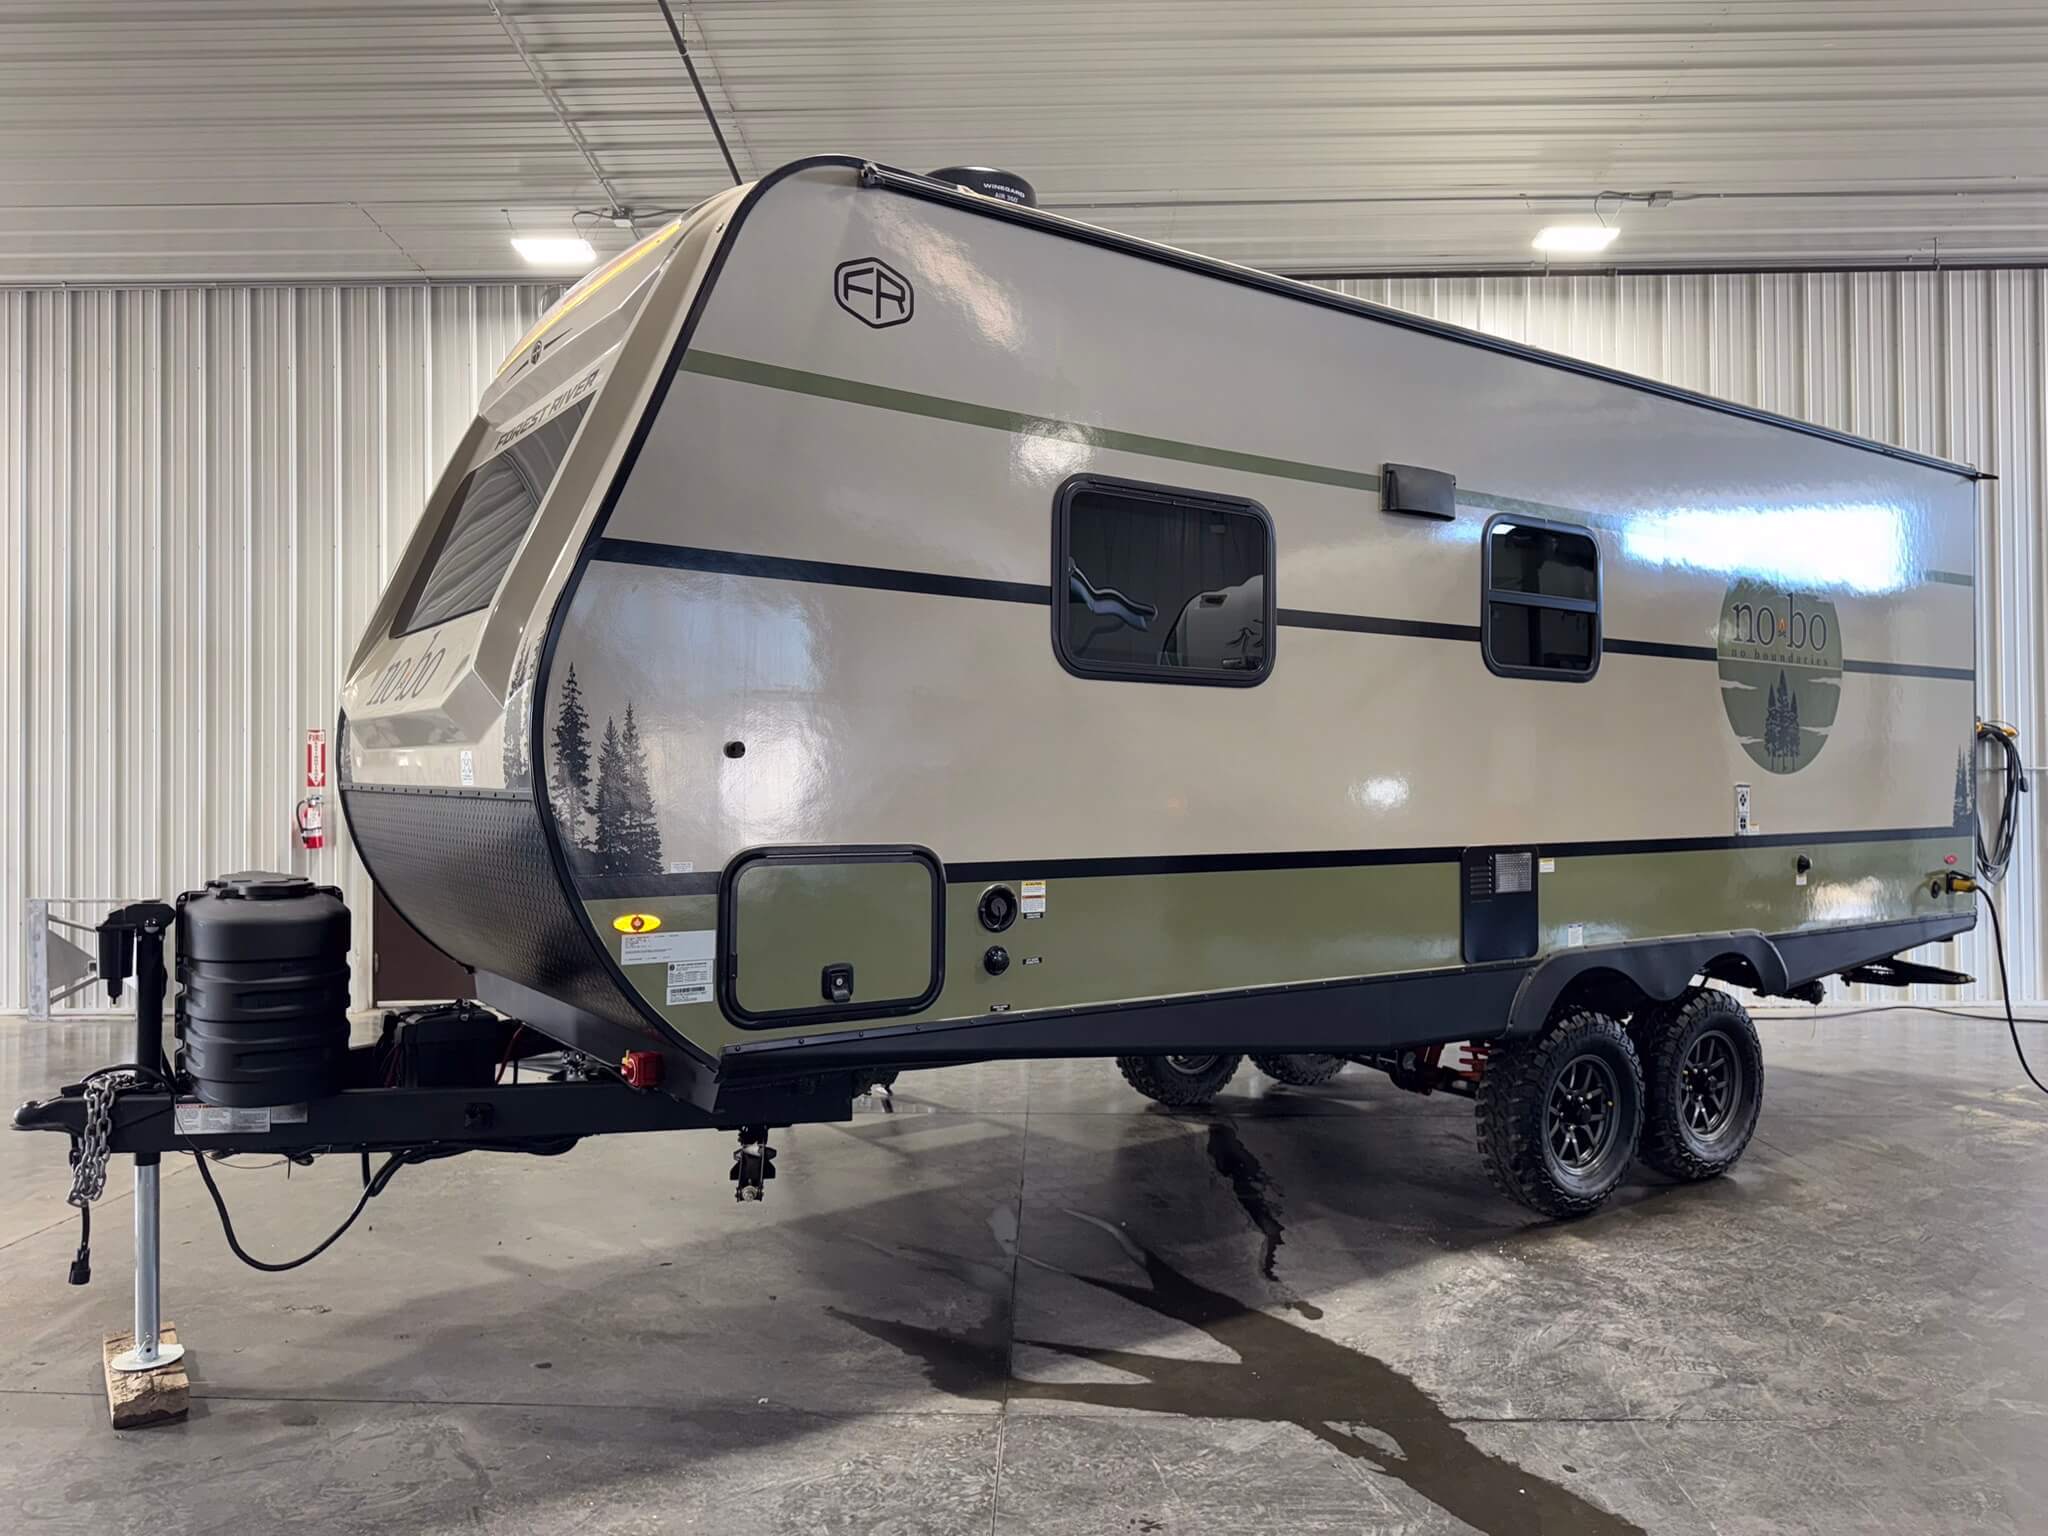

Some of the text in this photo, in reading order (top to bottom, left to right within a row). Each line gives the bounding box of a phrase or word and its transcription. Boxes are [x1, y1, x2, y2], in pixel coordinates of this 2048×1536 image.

[983, 182, 1025, 198] WINEGARD
[494, 368, 600, 451] FOREST RIVER
[1754, 648, 1829, 666] boundaries
